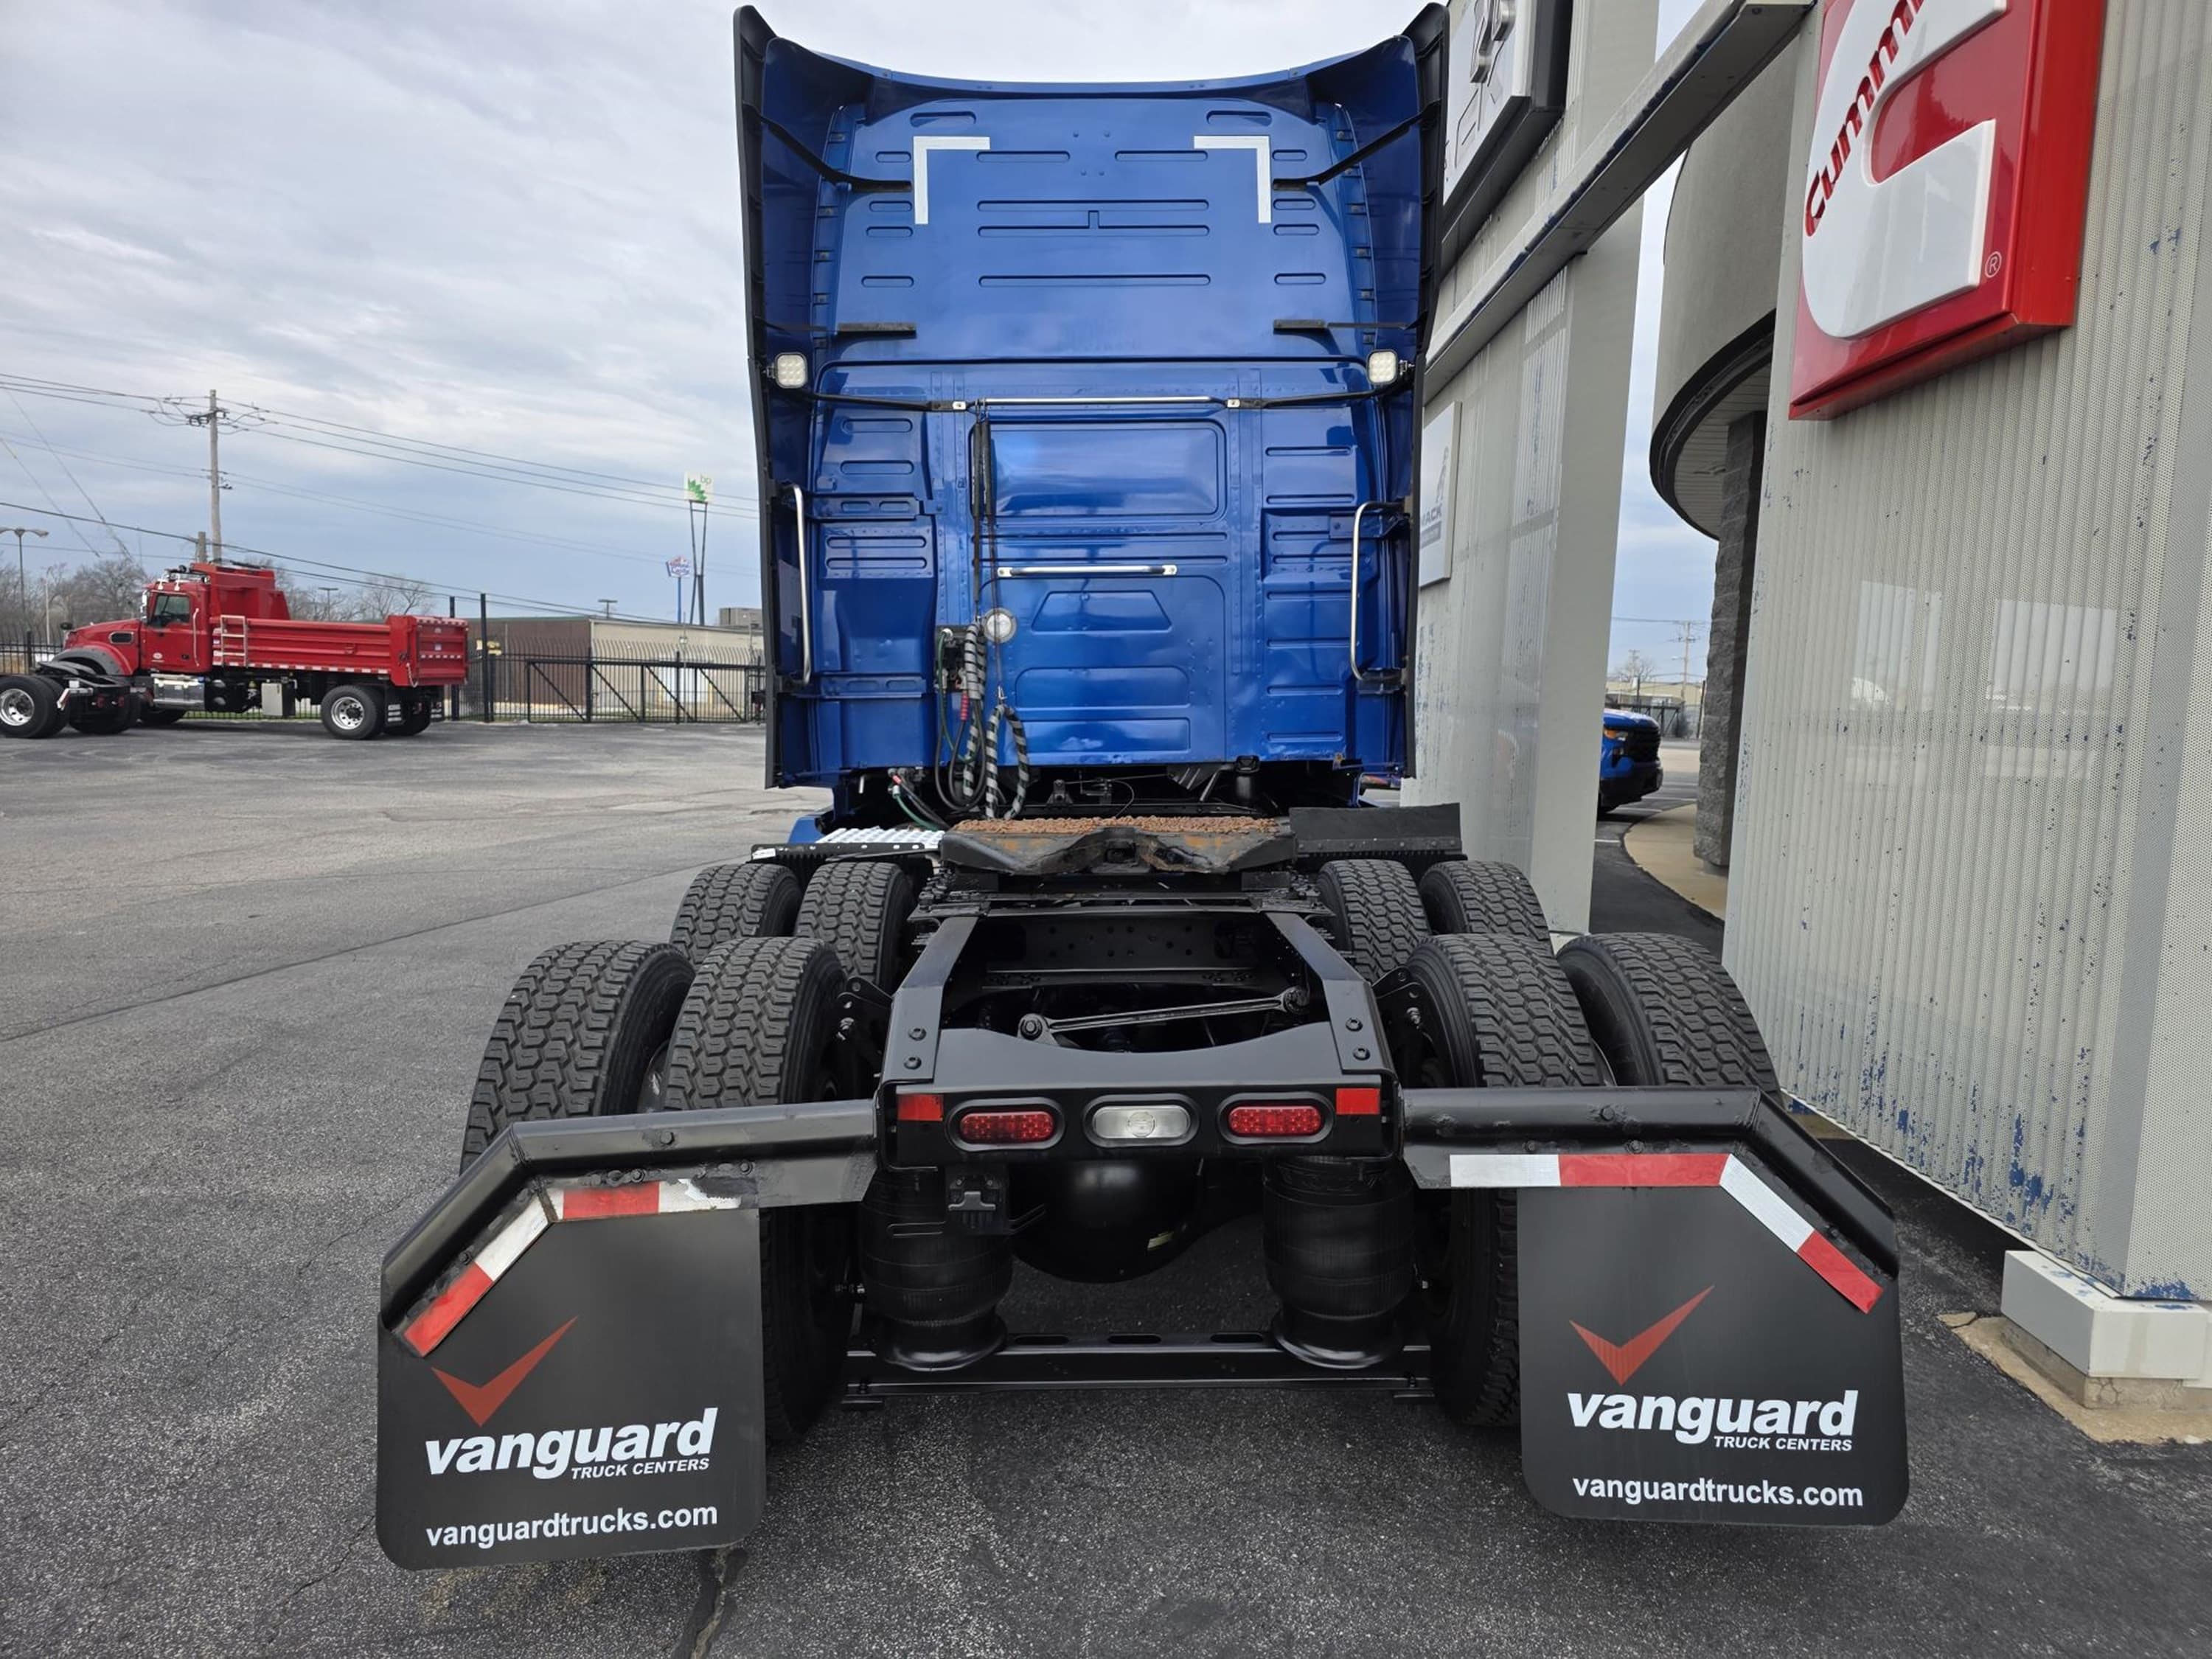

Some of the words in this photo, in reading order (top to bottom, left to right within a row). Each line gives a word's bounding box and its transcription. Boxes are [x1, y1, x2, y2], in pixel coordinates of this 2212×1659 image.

[700, 474, 712, 486] bp
[1567, 1390, 1859, 1444] vanguard
[425, 1407, 718, 1480] vanguard
[1714, 1436, 1770, 1450] TRUCK
[1776, 1438, 1852, 1452] CENTERS
[571, 1464, 628, 1480] TRUCK
[632, 1458, 710, 1475] CENTERS
[1572, 1478, 1863, 1506] vanguardtrucks.com
[426, 1506, 717, 1548] vanguardtrucks.com
